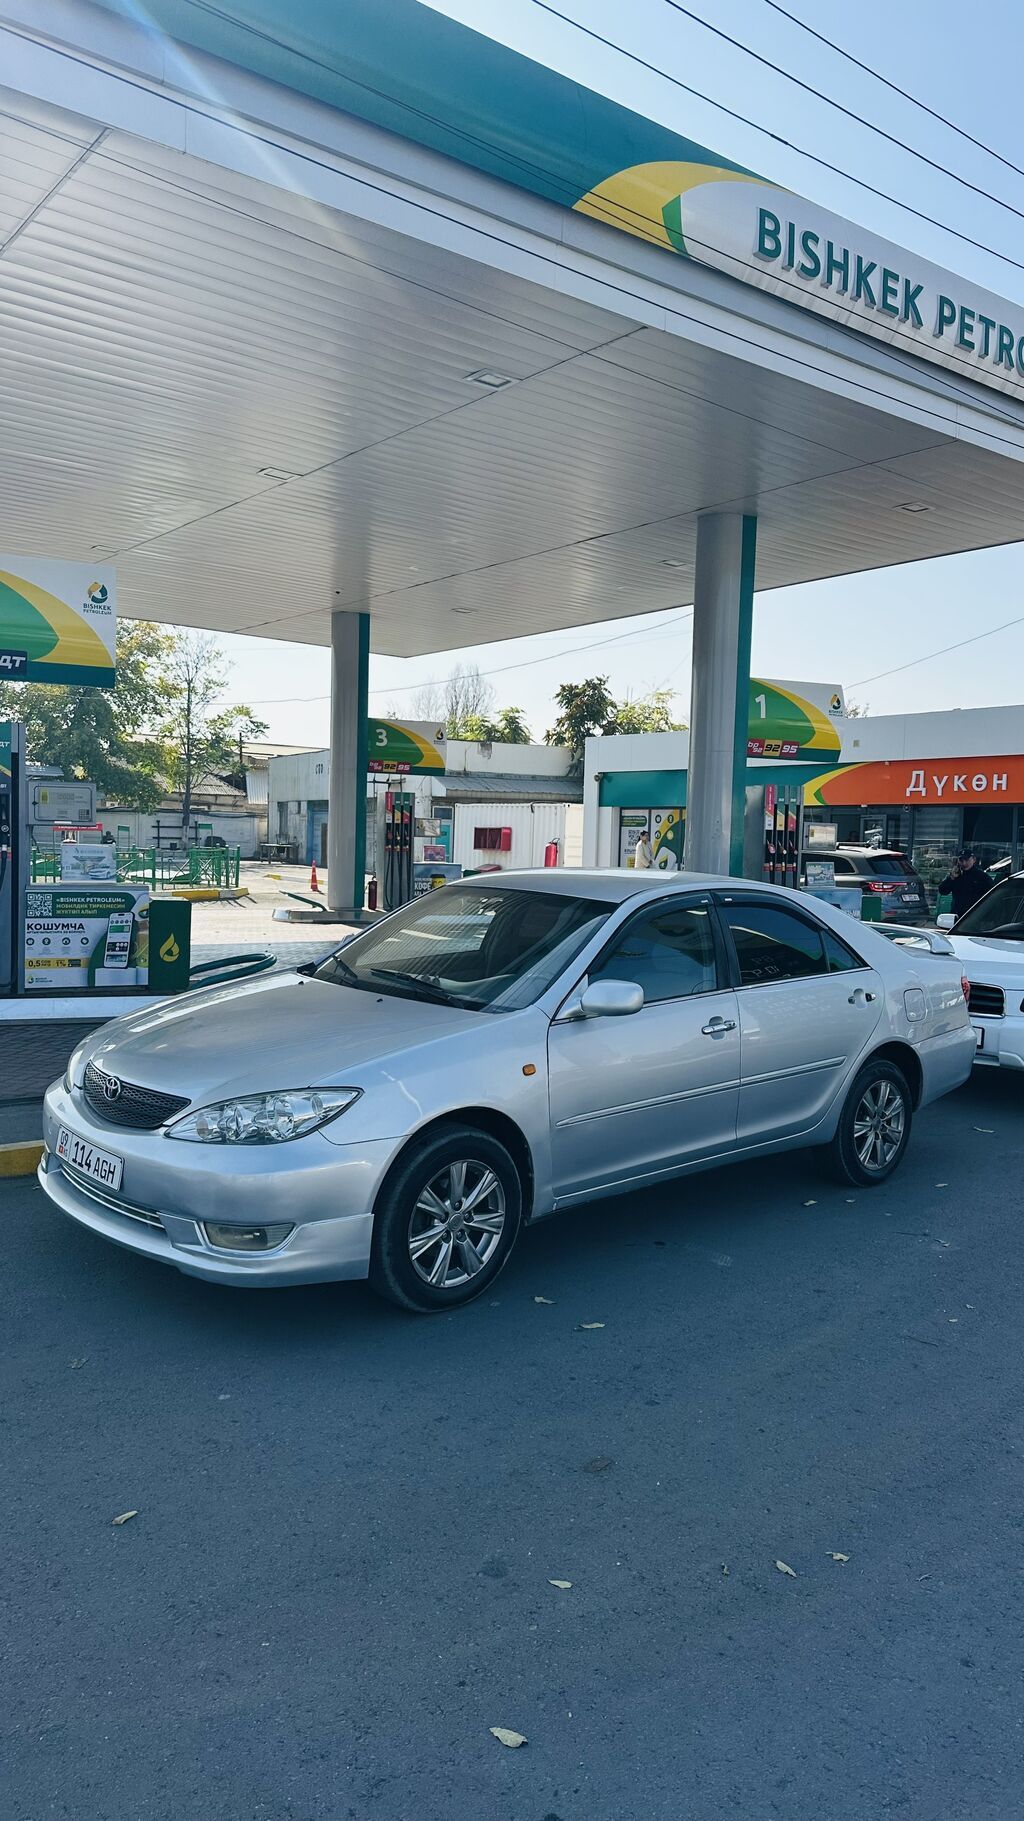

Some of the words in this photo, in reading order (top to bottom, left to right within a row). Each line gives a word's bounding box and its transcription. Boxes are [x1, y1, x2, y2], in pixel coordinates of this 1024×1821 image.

[754, 206, 924, 330] BISHKEK
[83, 603, 112, 612] BISHKEK
[0, 655, 26, 670] ДТ
[755, 694, 766, 719] 1
[375, 728, 388, 747] 3
[764, 743, 780, 752] 92
[782, 745, 798, 754] 95
[27, 923, 85, 931] КОШУМЧА
[72, 1140, 93, 1172] 114
[93, 1157, 116, 1184] AGH
